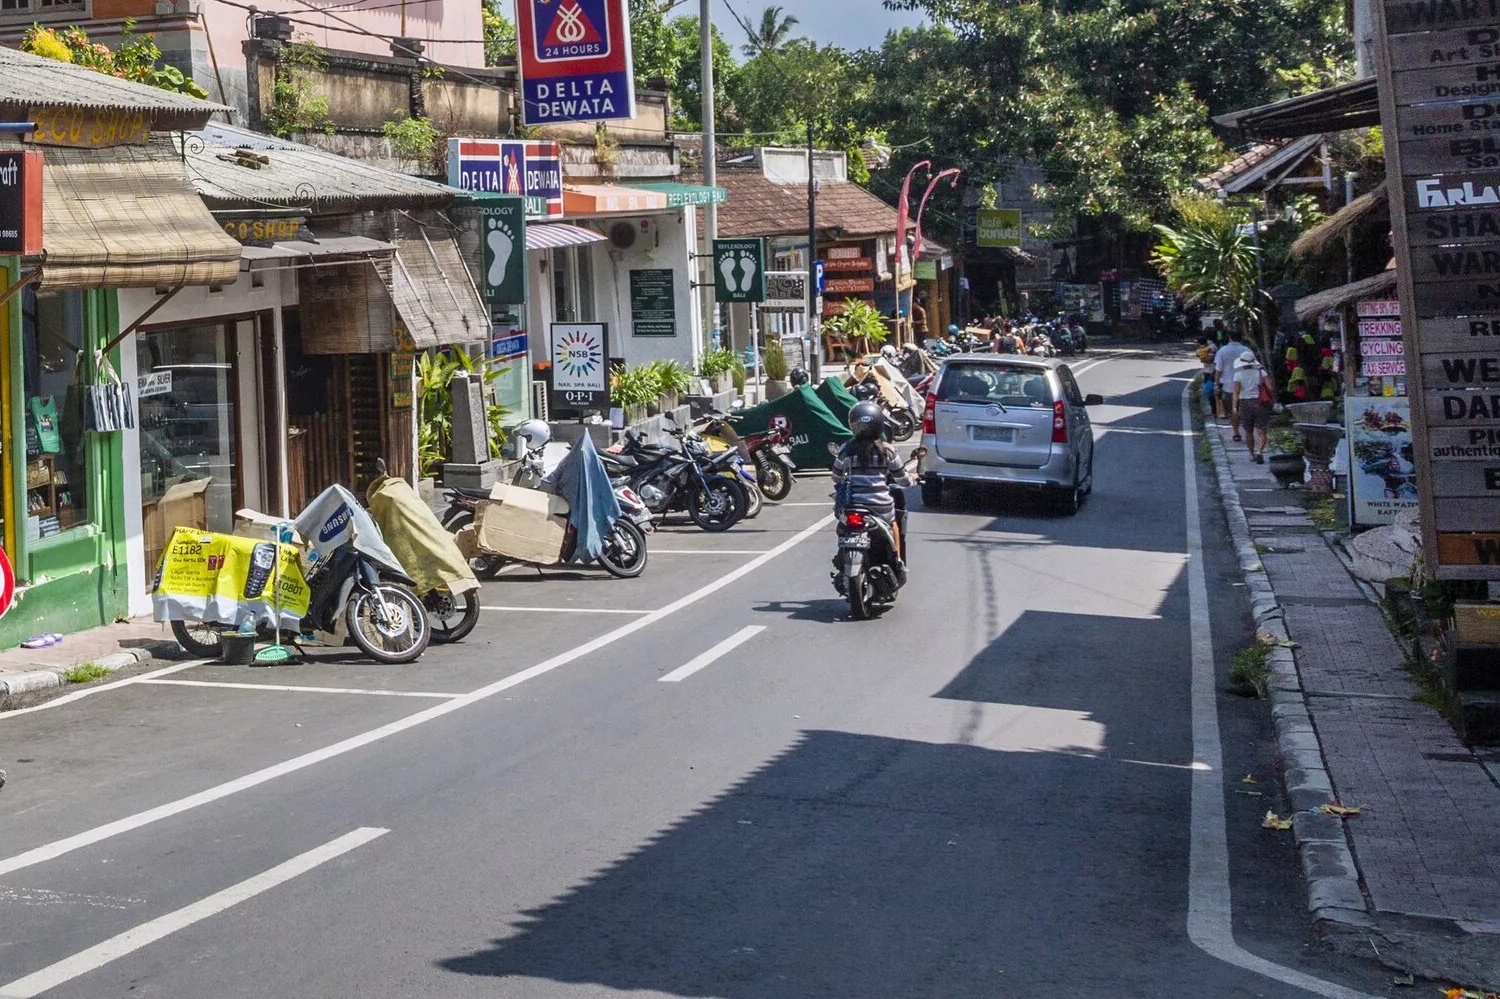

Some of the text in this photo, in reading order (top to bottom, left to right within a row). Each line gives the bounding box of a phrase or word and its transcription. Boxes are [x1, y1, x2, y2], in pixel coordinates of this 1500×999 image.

[545, 43, 600, 57] 24 HOURS
[537, 78, 614, 100] DELTA
[538, 98, 615, 118] DEWATA
[1411, 122, 1464, 137] Home
[462, 170, 559, 191] DELTA DEWATA
[224, 221, 248, 240] CO
[1358, 321, 1402, 336] TREKKING
[568, 350, 589, 358] NSB
[1361, 341, 1404, 356] CYCLING
[1363, 359, 1405, 375] TAXI SERVICE
[1367, 501, 1392, 509] WHITE
[172, 545, 202, 556] E1182
